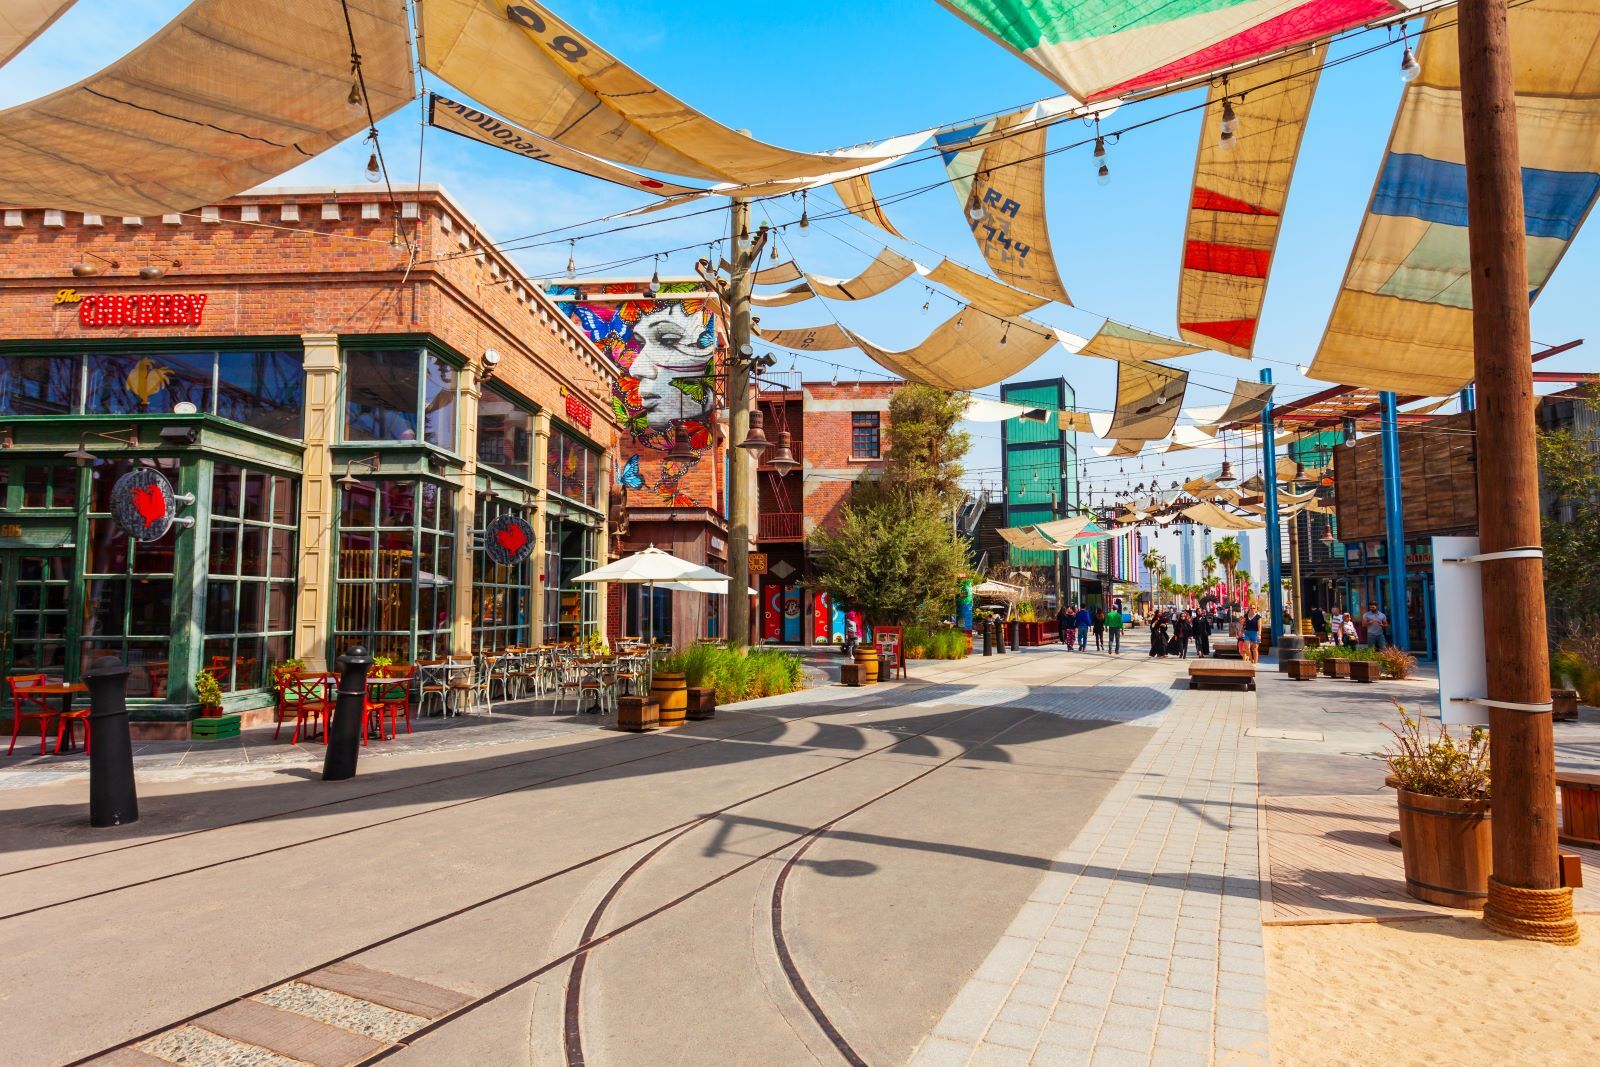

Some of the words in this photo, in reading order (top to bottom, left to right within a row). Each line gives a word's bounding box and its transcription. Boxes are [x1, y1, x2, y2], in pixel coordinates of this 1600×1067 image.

[983, 188, 1021, 218] RA
[54, 289, 82, 304] The
[80, 294, 208, 326] CHICKERY
